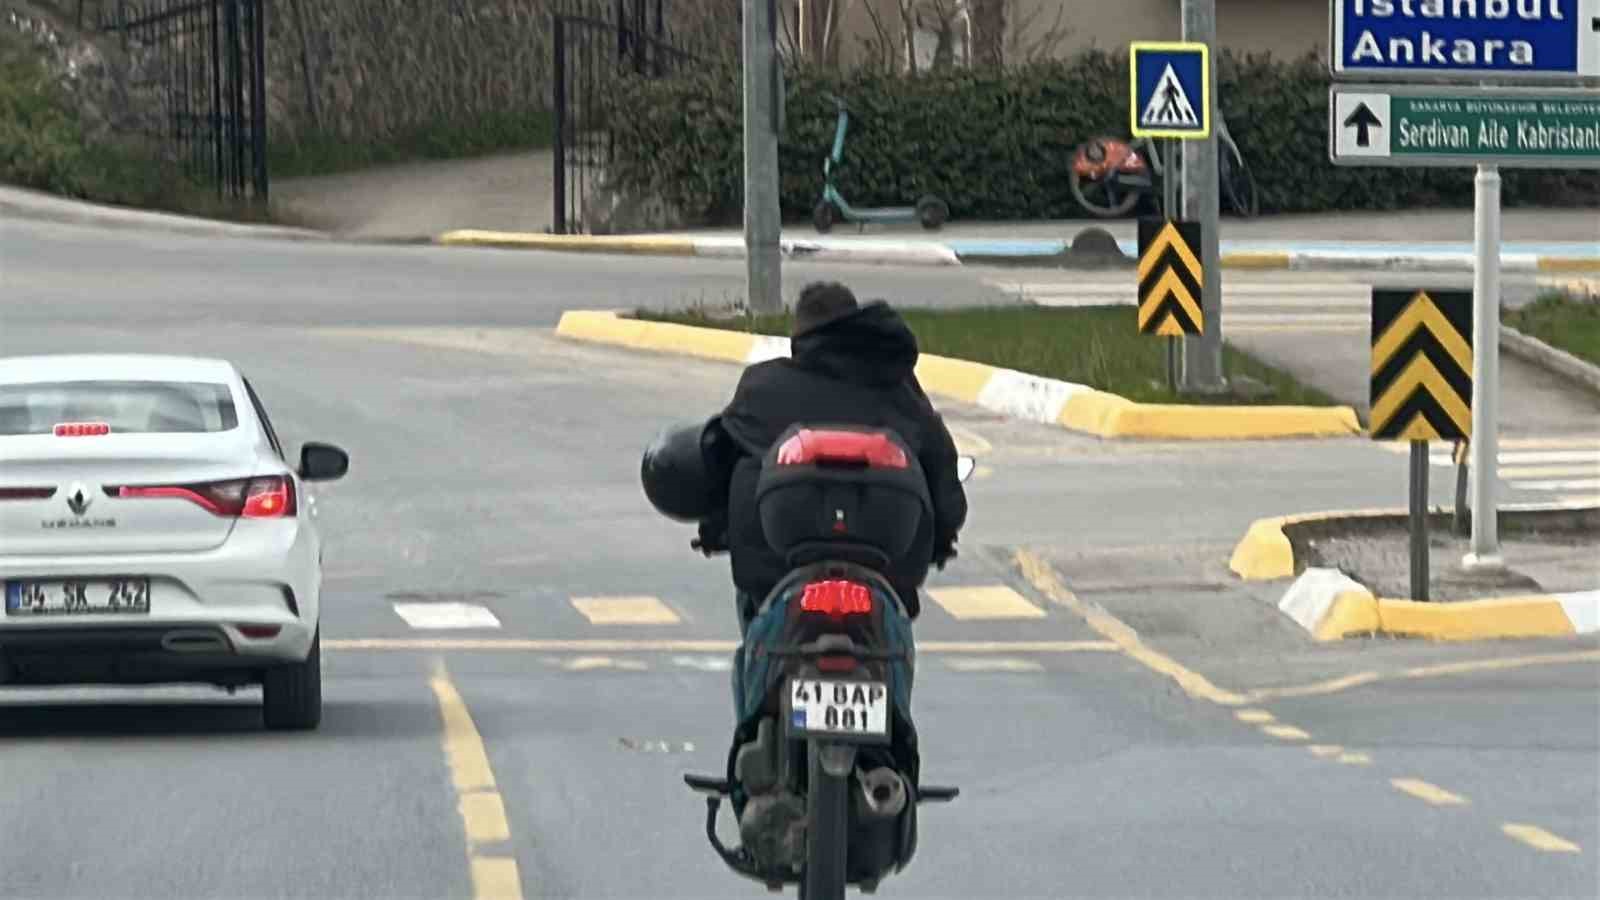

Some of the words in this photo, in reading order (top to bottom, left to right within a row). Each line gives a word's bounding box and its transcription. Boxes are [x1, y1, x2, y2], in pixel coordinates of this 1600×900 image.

[1351, 29, 1534, 65] Ankara
[1400, 117, 1469, 148] Serdivan
[1478, 118, 1509, 149] Aile
[107, 577, 145, 608] 242
[796, 679, 821, 703] 41
